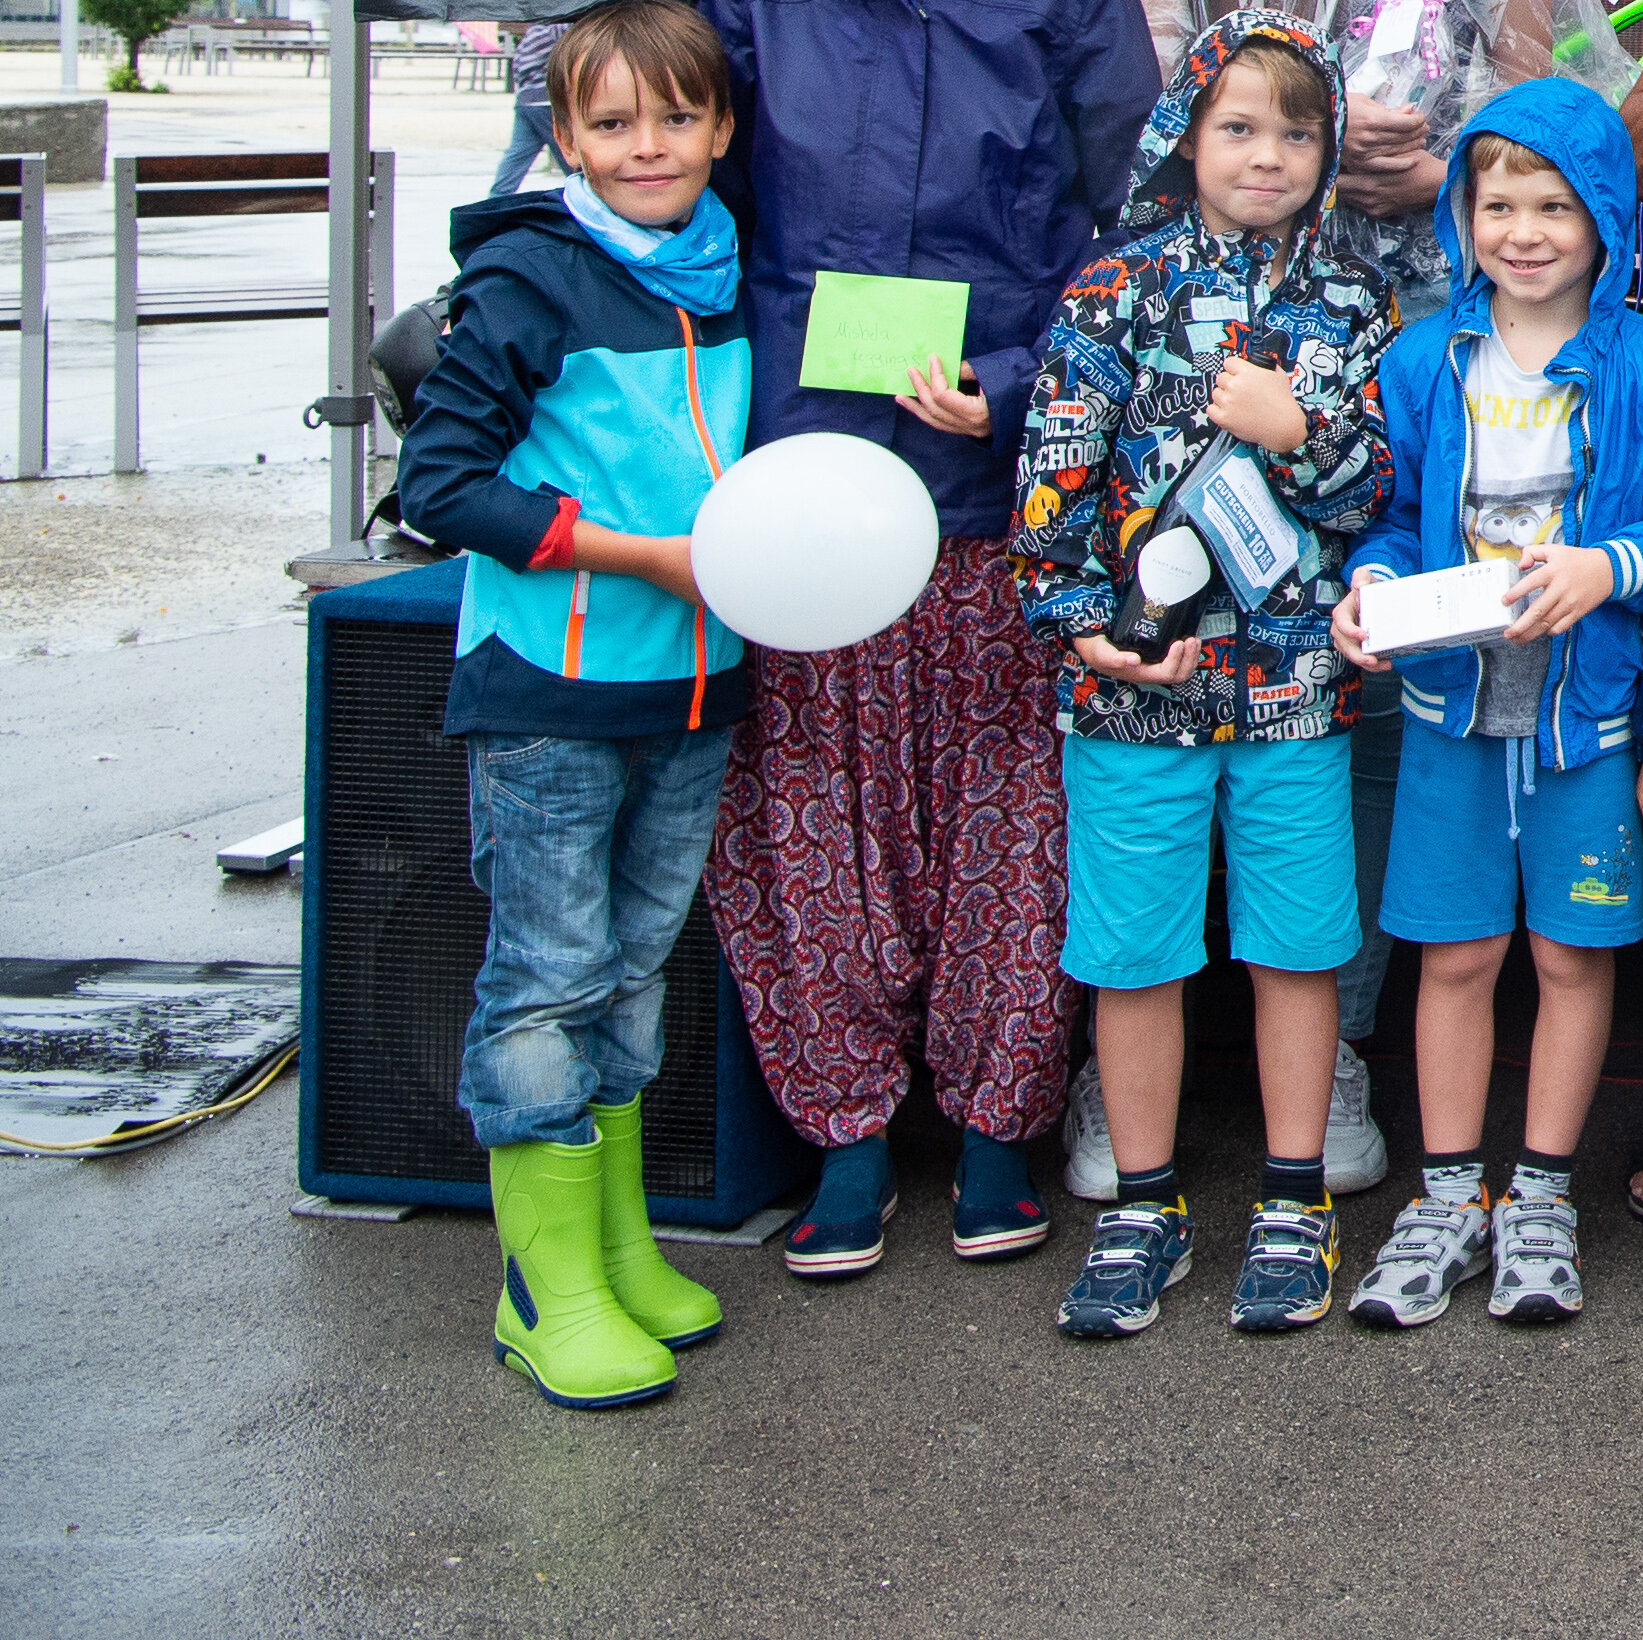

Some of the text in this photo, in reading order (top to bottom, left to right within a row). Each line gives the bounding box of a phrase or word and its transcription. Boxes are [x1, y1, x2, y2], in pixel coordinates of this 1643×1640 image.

[1214, 479, 1257, 535] GUTSCHEIN
[1248, 623, 1288, 647] BEAC
[1252, 685, 1301, 701] FASTER
[1419, 1210, 1450, 1218] GEOX
